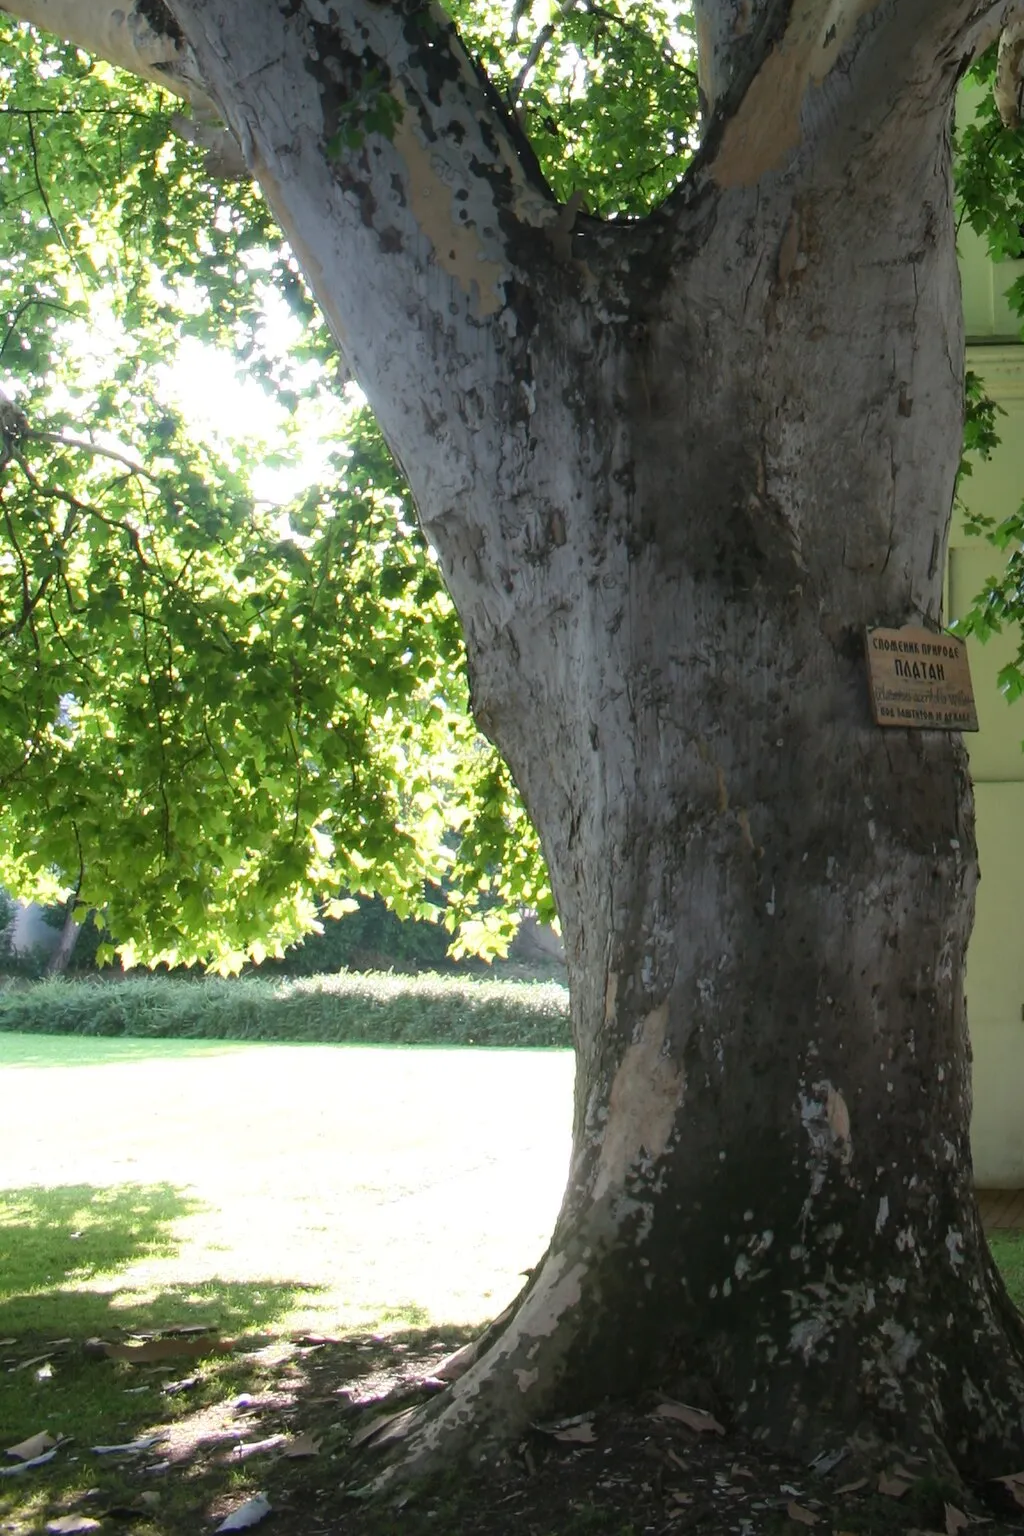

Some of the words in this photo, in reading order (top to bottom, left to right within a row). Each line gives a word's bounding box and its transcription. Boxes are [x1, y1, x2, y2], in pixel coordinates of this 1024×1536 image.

[873, 638, 919, 654] СПОМЕНИК
[922, 643, 959, 658] ПРИРОДЕ
[894, 659, 945, 681] ПЛАТАН
